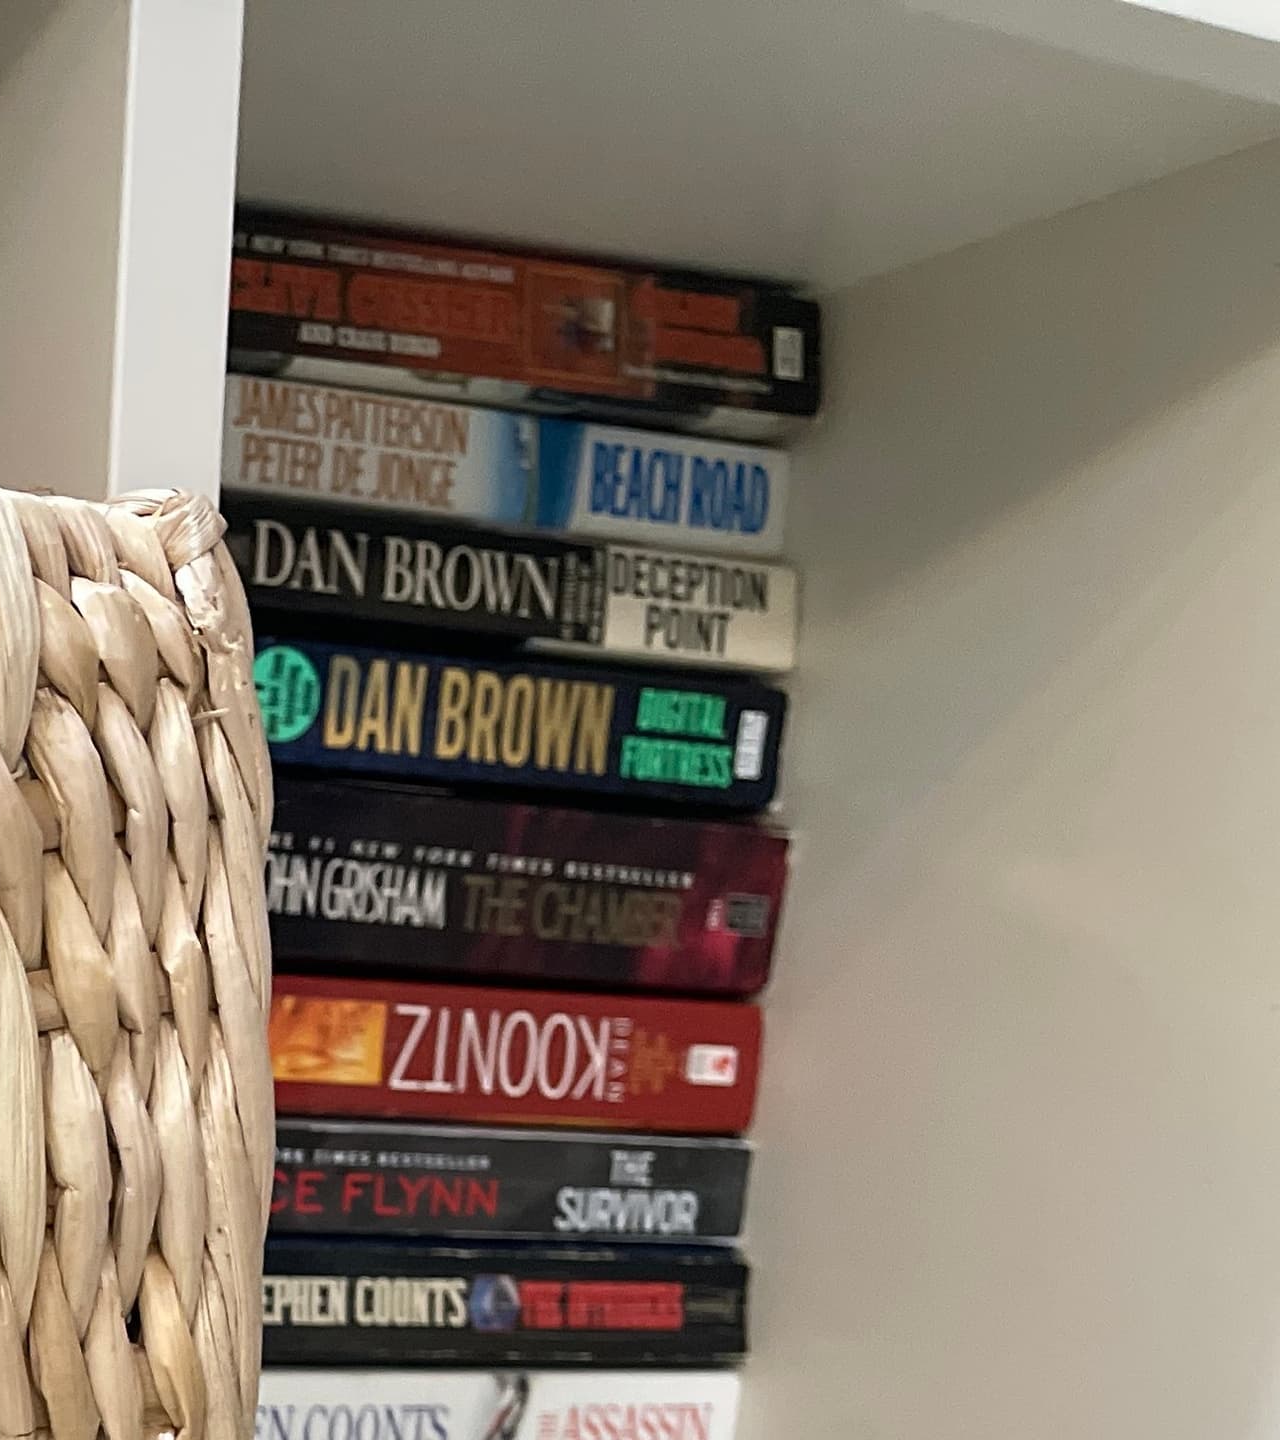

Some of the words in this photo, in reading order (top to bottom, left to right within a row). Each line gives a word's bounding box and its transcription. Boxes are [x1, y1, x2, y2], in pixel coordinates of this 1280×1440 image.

[232, 377, 320, 434] JAMES
[323, 391, 470, 456] PATTERSON
[243, 433, 323, 490] PETER
[331, 446, 367, 496] DE
[591, 441, 683, 524] BEACH
[687, 456, 771, 535] ROAD
[254, 519, 369, 597] DAN
[382, 536, 561, 621] BROWN
[609, 552, 769, 613] DECEPTION
[645, 603, 731, 657] POINT
[323, 655, 428, 757] DAN
[434, 666, 616, 777] BROWN
[321, 857, 448, 931] GRISHAM
[463, 872, 530, 937] THE
[389, 1004, 611, 1100] KOONTZ
[342, 1172, 500, 1218] FLYNN
[553, 1185, 698, 1233] SURVIVOR
[263, 1275, 348, 1327] EPHEN
[355, 1277, 467, 1328] COONTS
